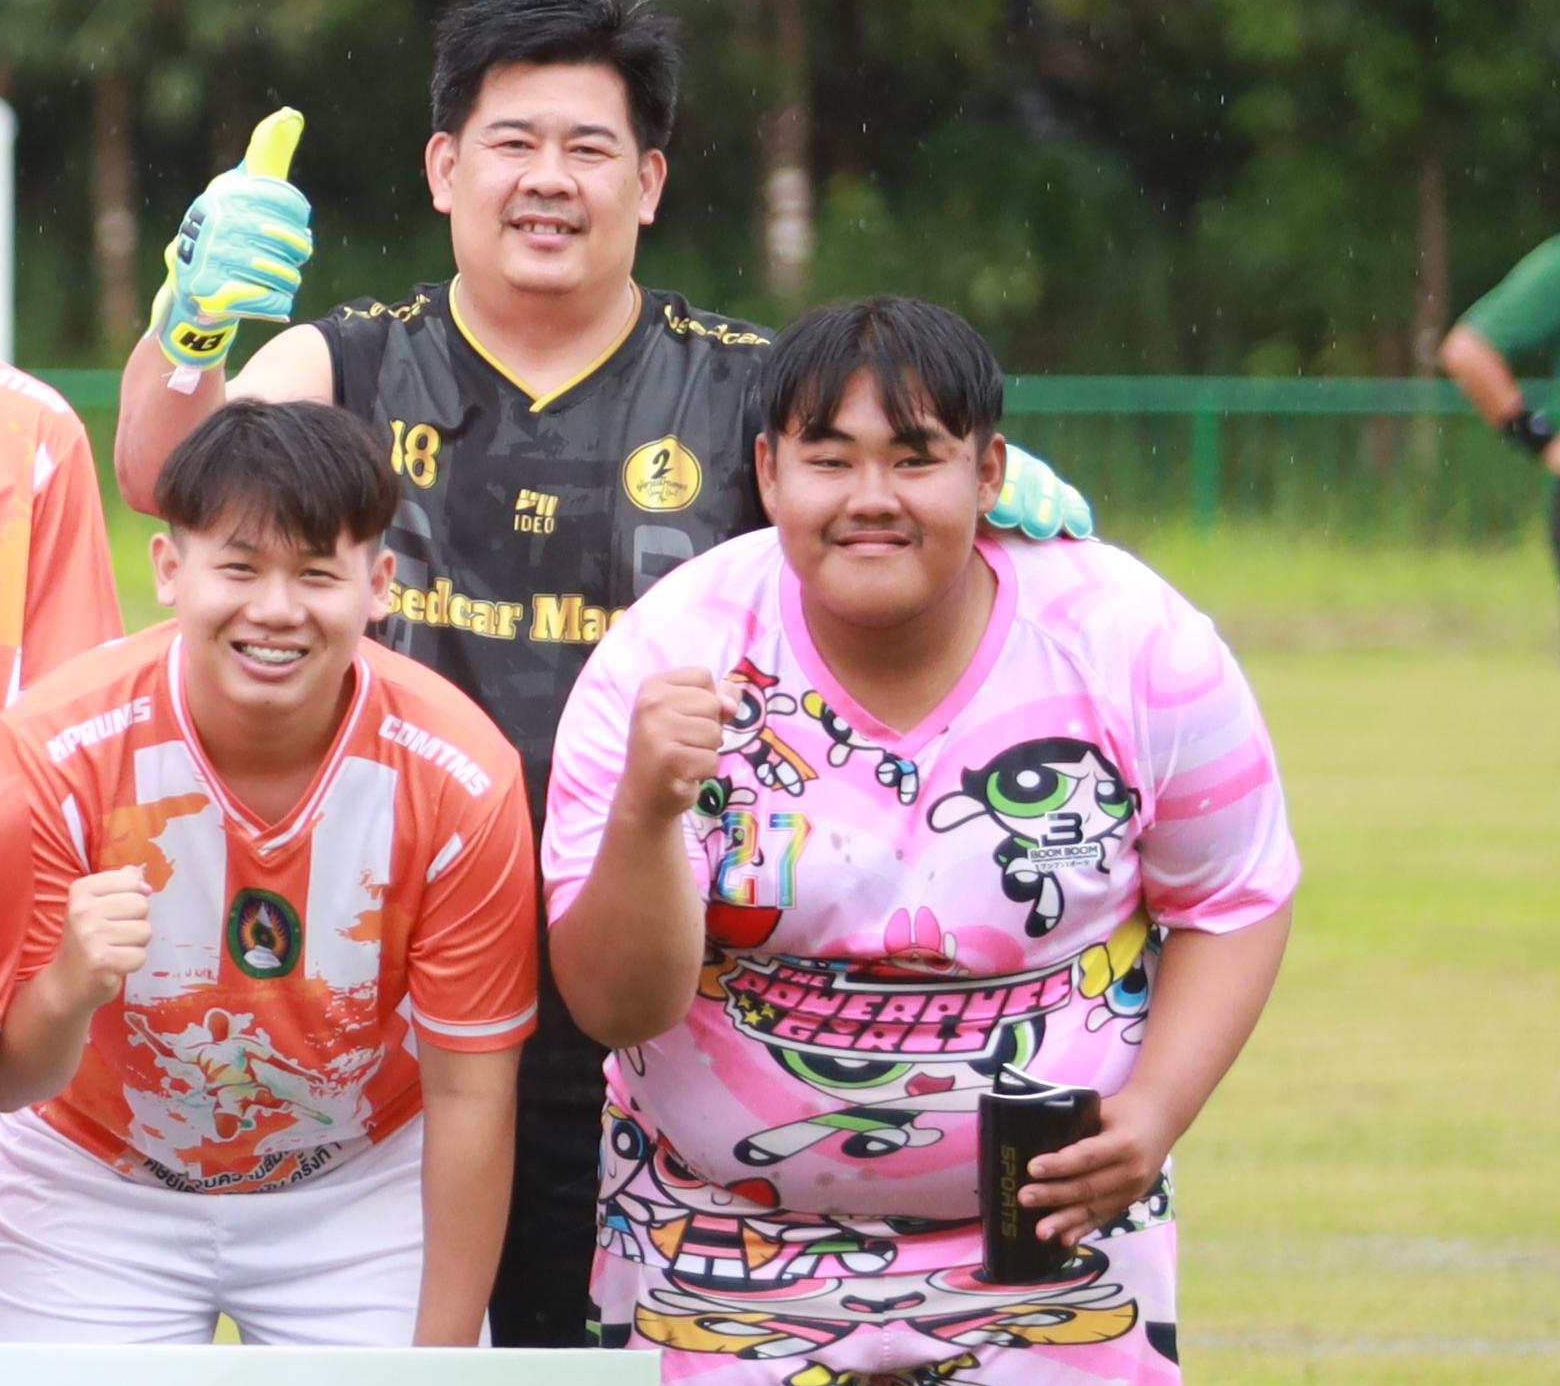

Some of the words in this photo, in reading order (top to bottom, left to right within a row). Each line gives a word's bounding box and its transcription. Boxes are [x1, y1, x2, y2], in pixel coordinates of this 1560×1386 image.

[390, 420, 441, 489] 18
[651, 449, 674, 480] 2
[514, 514, 555, 533] IDEO
[45, 696, 152, 764] KPRUMS
[377, 714, 492, 798] COMTMS
[719, 810, 815, 909] 27
